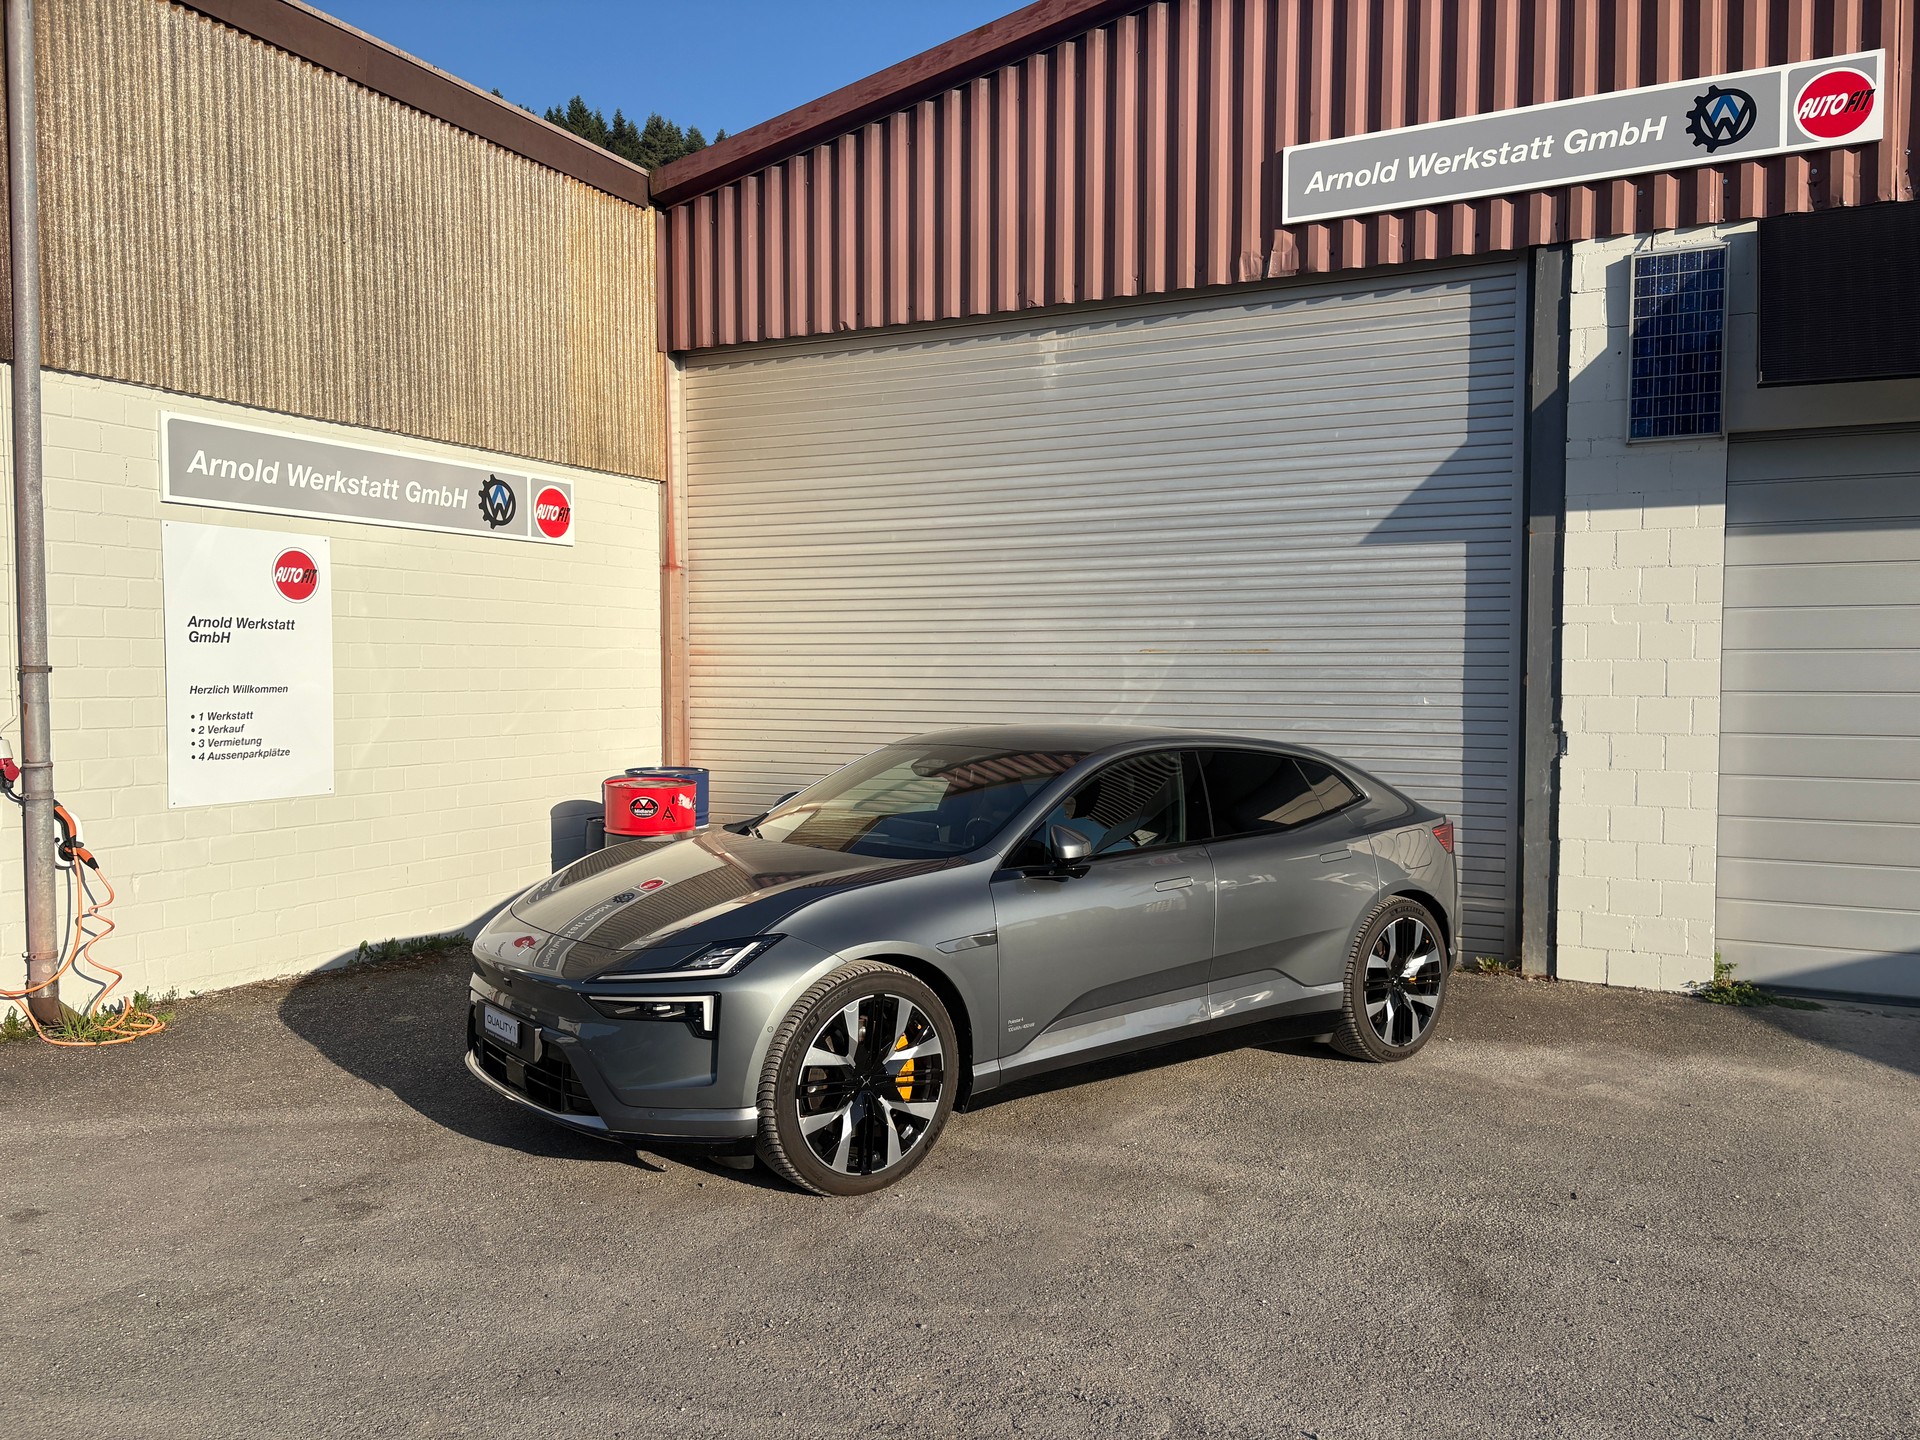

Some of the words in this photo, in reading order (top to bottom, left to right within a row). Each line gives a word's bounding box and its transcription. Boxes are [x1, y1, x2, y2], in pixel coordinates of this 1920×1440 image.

[1799, 88, 1876, 120] AUTOFIT
[1304, 158, 1400, 195] Arnold
[1408, 135, 1555, 179] Werkstatt
[1563, 115, 1668, 155] GmbH
[186, 449, 280, 485] Arnold
[287, 462, 400, 501] Werkstatt
[405, 480, 468, 509] GmbH
[536, 503, 571, 523] AUTOFIT
[275, 566, 318, 584] AUTOFIT
[187, 615, 233, 628] Arnold
[236, 617, 296, 630] Werkstatt
[188, 630, 231, 643] GmbH
[189, 684, 230, 694] Herzlich
[232, 684, 289, 694] Willkommen
[198, 711, 204, 721] 1
[207, 711, 254, 720] Werkstatt
[198, 725, 205, 735] 2
[207, 723, 245, 734] Verkauf
[198, 738, 205, 748] 3
[207, 737, 262, 747] Vermietung
[198, 752, 205, 761] 4
[207, 748, 291, 761] Aussenparkplätze
[486, 1014, 513, 1034] QUALITY
